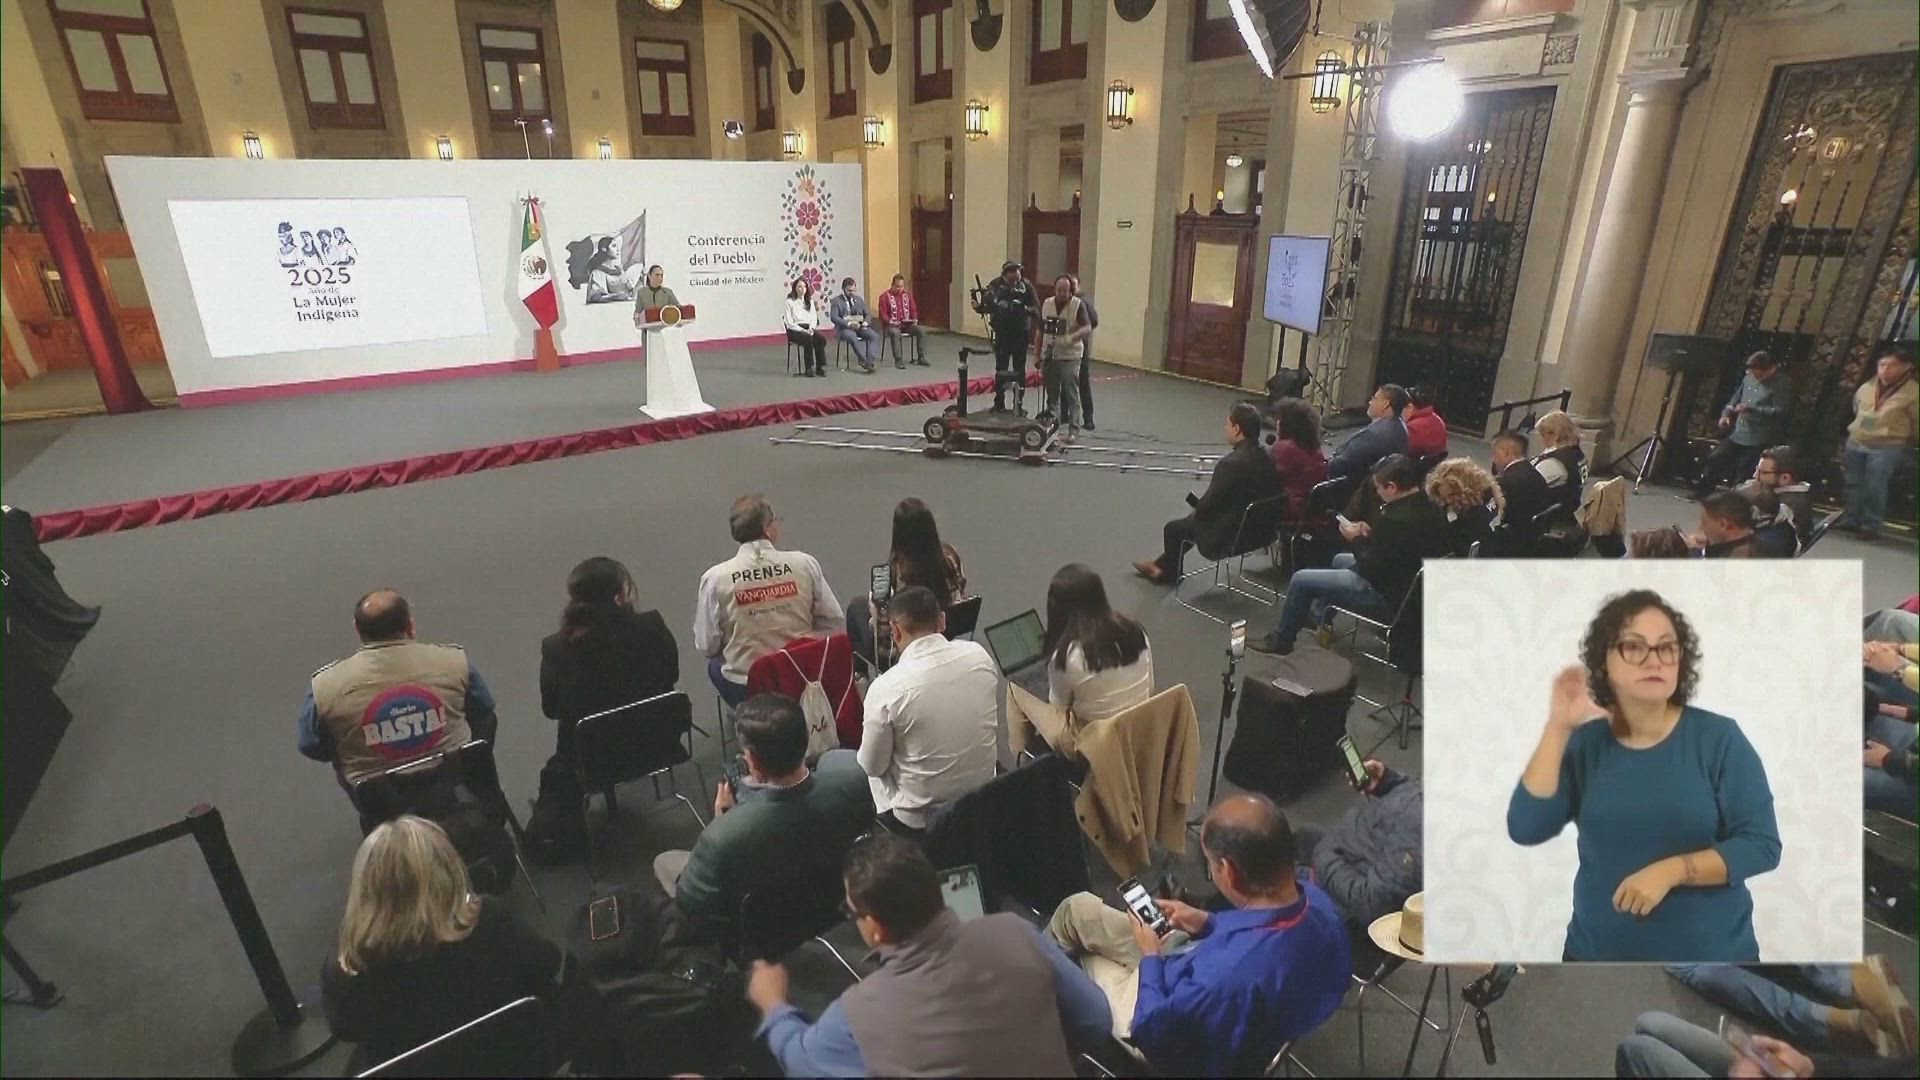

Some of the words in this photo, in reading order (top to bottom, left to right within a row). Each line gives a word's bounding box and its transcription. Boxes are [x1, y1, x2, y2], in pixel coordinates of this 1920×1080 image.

[687, 234, 765, 246] Conferencia
[689, 253, 709, 266] del
[713, 251, 756, 264] Pueblo
[288, 267, 351, 286] 2025
[689, 277, 720, 286] Ciudad
[722, 277, 732, 285] de
[734, 275, 764, 285] México
[293, 297, 311, 308] La
[315, 295, 356, 308] Mujer
[731, 563, 793, 583] PRENSA
[736, 584, 796, 602] VANGUARDIA
